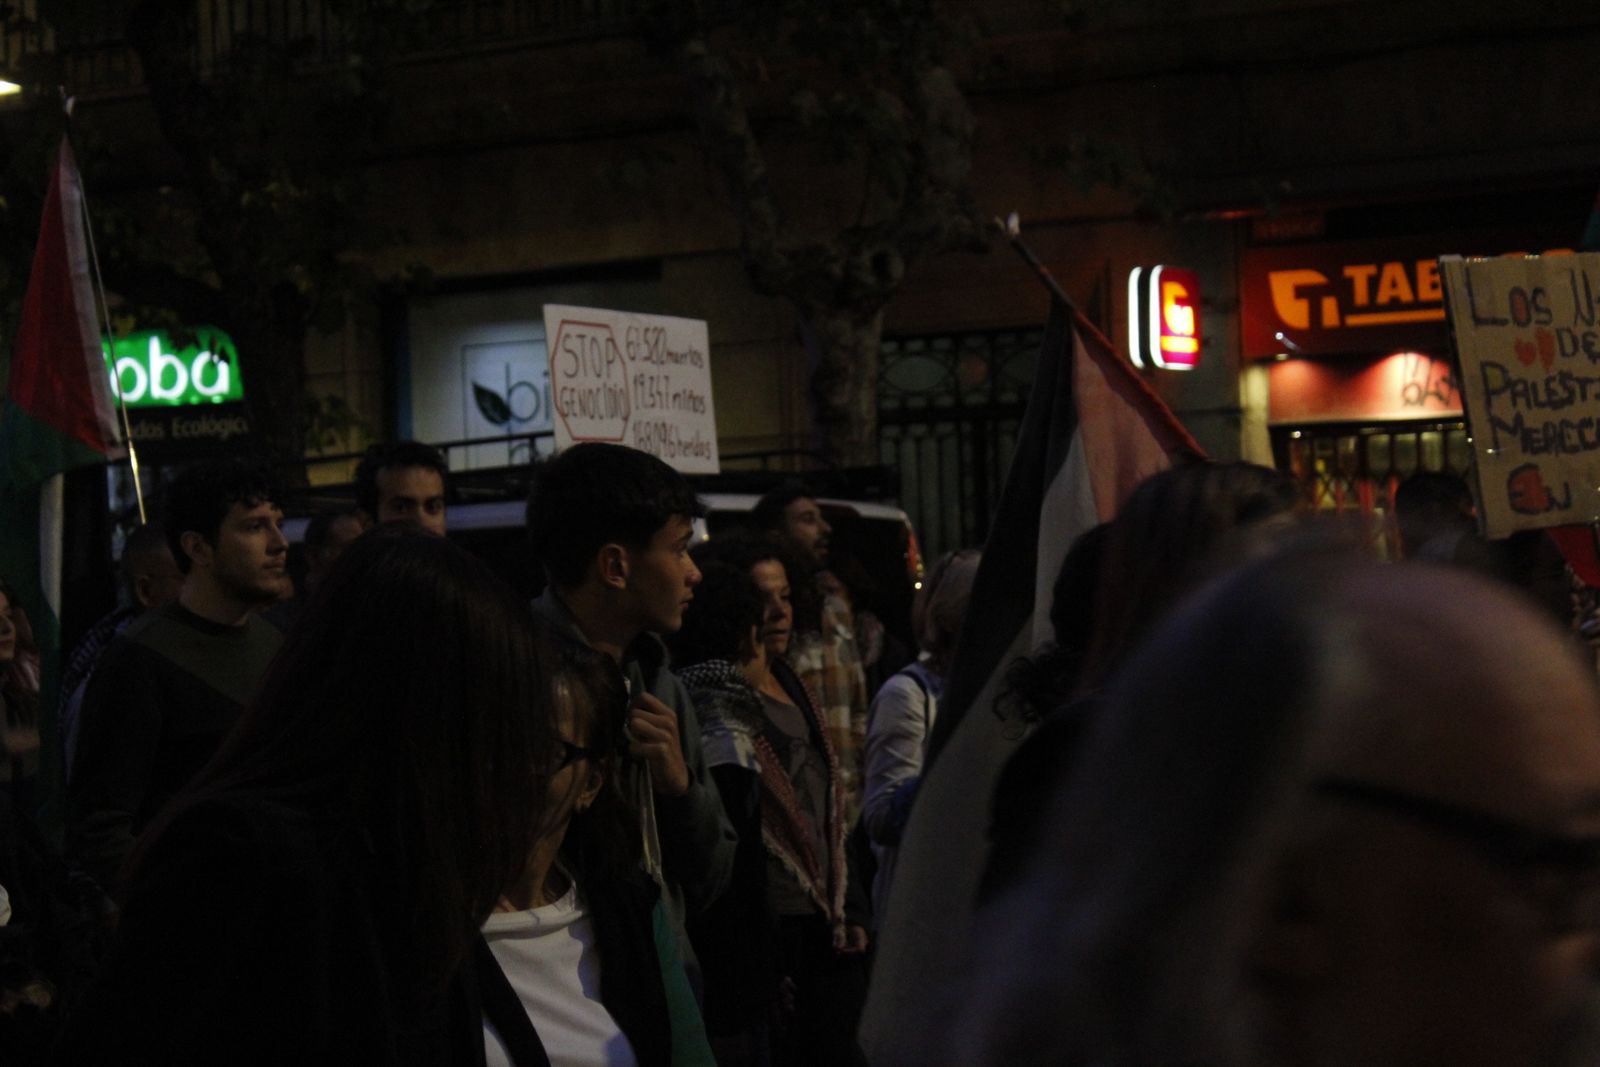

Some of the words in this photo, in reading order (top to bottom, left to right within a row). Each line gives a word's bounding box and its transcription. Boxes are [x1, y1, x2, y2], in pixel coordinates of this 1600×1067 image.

[1342, 259, 1442, 307] TAB
[1465, 267, 1553, 328] LOS
[1569, 267, 1600, 327] N
[103, 335, 231, 402] oba
[562, 333, 616, 378] STOP
[504, 361, 550, 424] bi
[1507, 462, 1572, 515] EN
